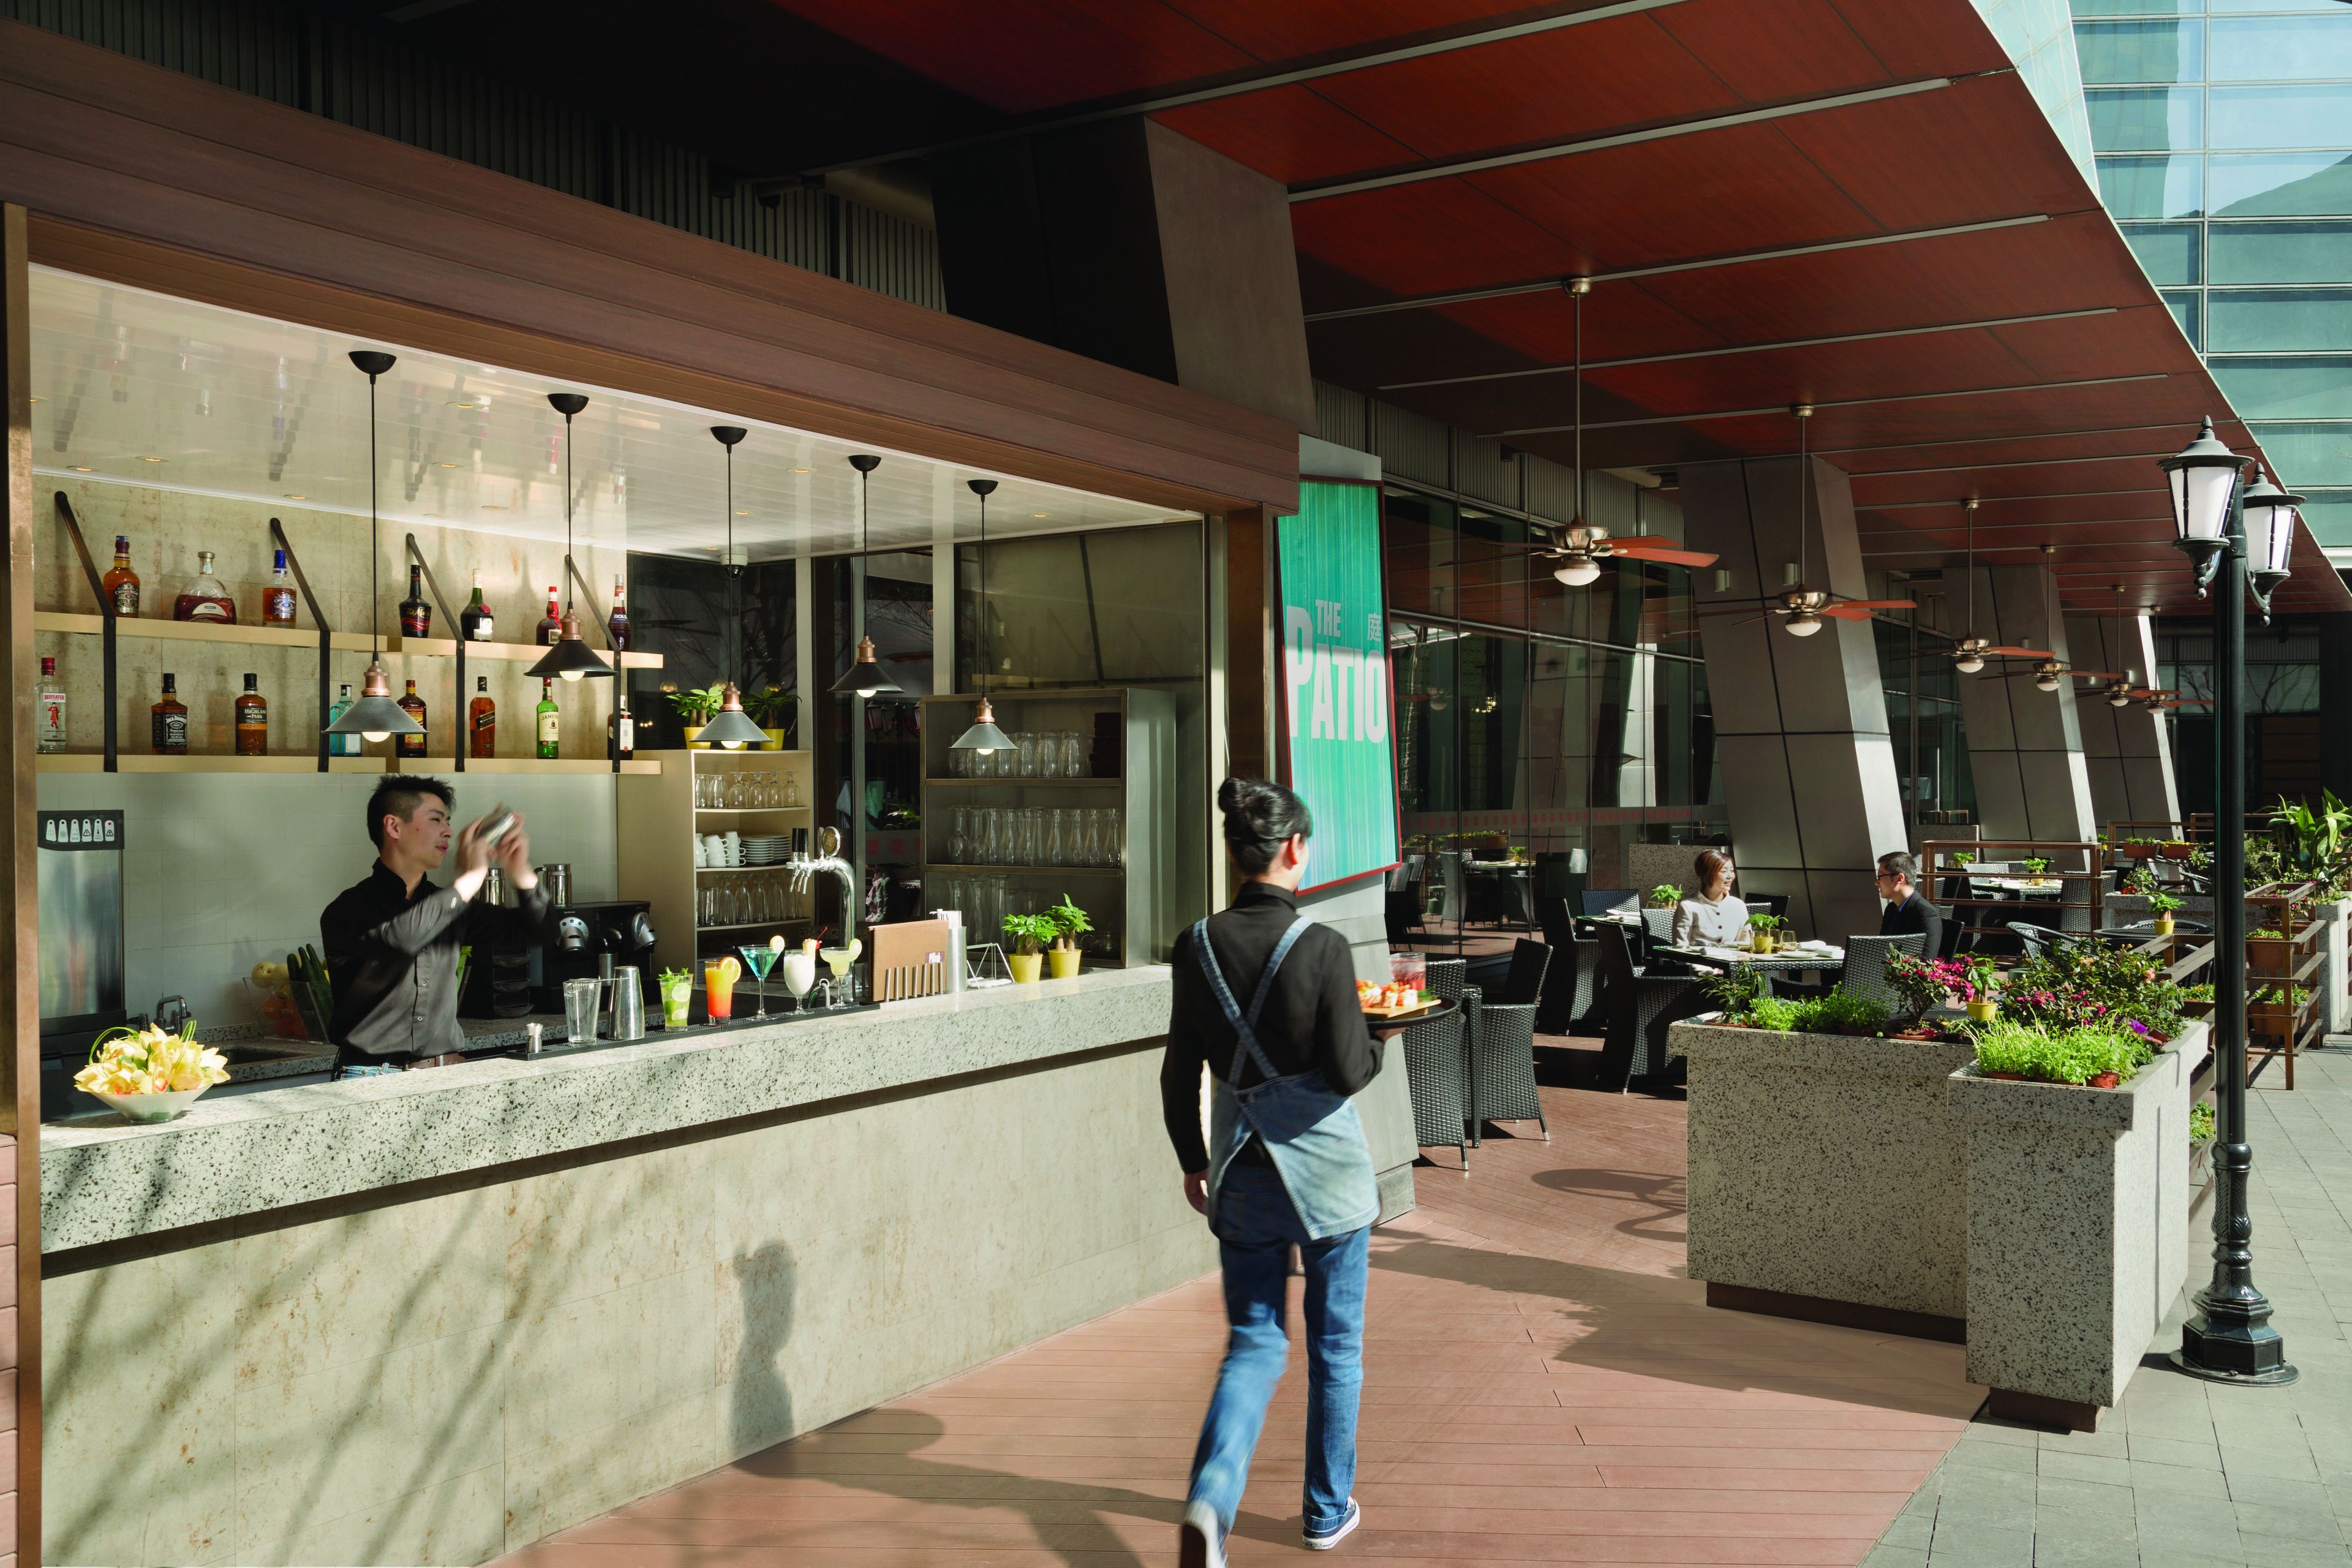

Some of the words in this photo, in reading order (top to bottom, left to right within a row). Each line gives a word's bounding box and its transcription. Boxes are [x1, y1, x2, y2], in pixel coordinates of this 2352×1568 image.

[1316, 599, 1341, 638] THE
[1367, 612, 1382, 642] 庭
[1286, 605, 1387, 743] PATIO
